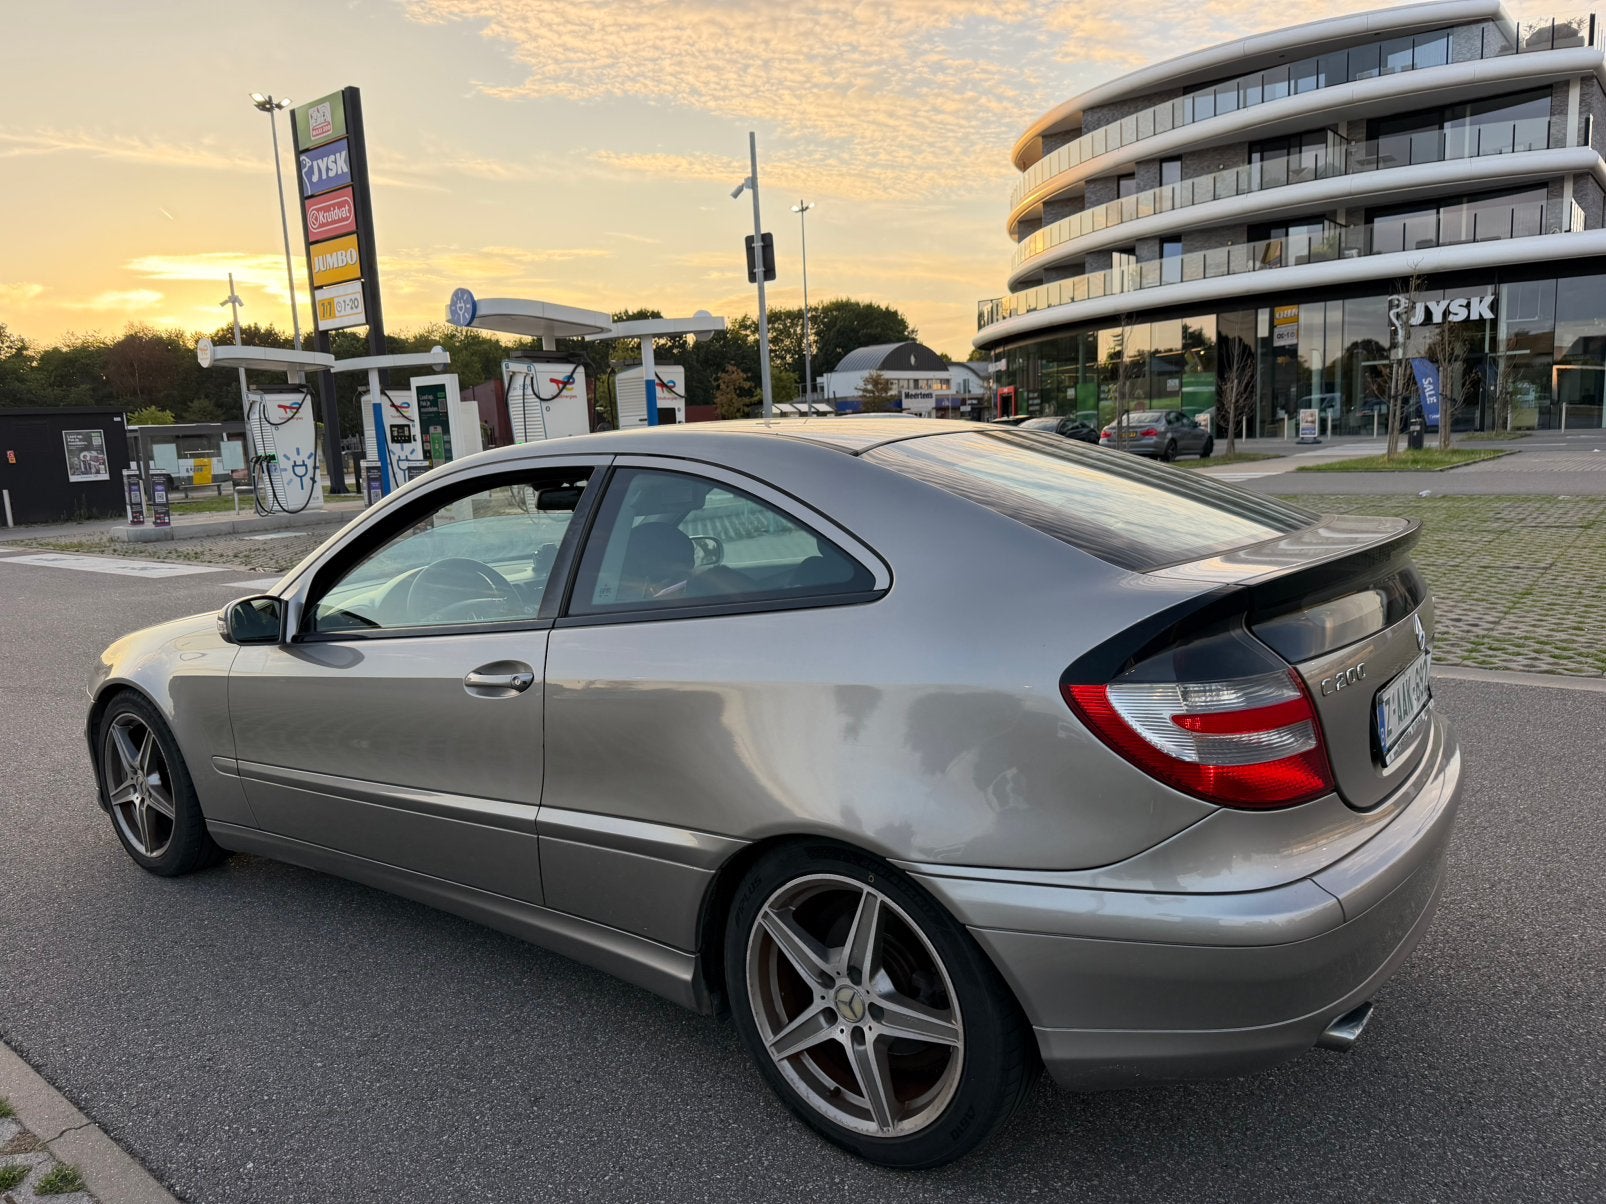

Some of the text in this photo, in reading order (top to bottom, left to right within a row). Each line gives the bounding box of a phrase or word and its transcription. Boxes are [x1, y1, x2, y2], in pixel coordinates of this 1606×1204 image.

[312, 150, 348, 183] JYSK
[319, 204, 350, 225] Kruidvat
[314, 248, 357, 274] JUMBO
[1410, 295, 1496, 326] JYSK
[1422, 376, 1437, 405] SALE
